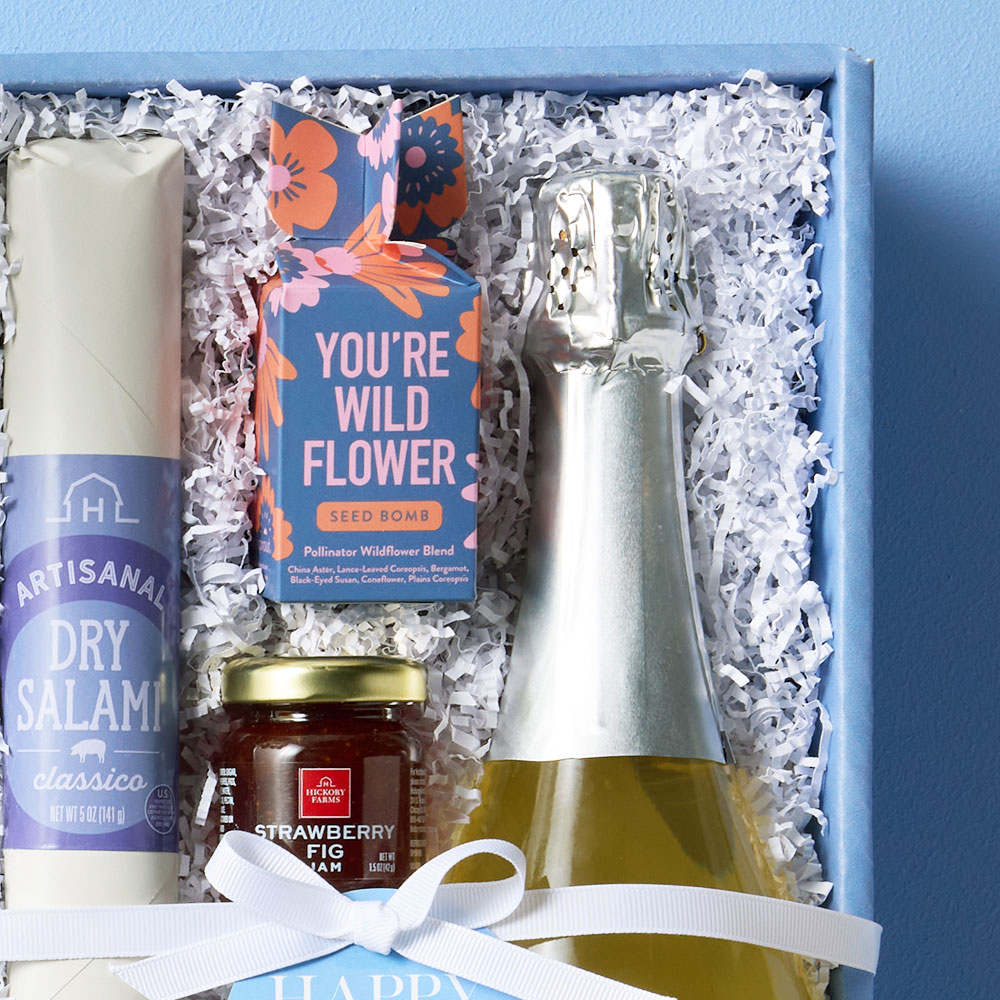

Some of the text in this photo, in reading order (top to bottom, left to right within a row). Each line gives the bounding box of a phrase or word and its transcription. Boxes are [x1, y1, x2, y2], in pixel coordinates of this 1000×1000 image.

[315, 331, 450, 378] YOU'RE
[335, 385, 429, 432] WILD
[303, 438, 456, 487] FLOWER
[330, 509, 429, 522] SEED BOMB
[303, 544, 455, 557] Pollinator Wildflower Blend
[287, 564, 470, 575] China Aster, Lance-Leaved Coreopsis, Bergamot,
[16, 558, 166, 611] ARTISANAL
[290, 574, 469, 586] Black-Eyed Susan, Coneflower, Plains Coreopsis
[49, 619, 130, 671] DRY
[16, 679, 162, 732] SALAMI
[33, 766, 148, 793] classico
[306, 788, 346, 796] HICKORY
[311, 796, 341, 804] FARMS
[49, 805, 64, 823] NET
[65, 805, 77, 823] WT
[79, 805, 85, 823] 5
[86, 805, 97, 823] OZ
[98, 805, 115, 825] (141
[254, 823, 396, 841] STRAWBERRY
[306, 843, 345, 860] FIG
